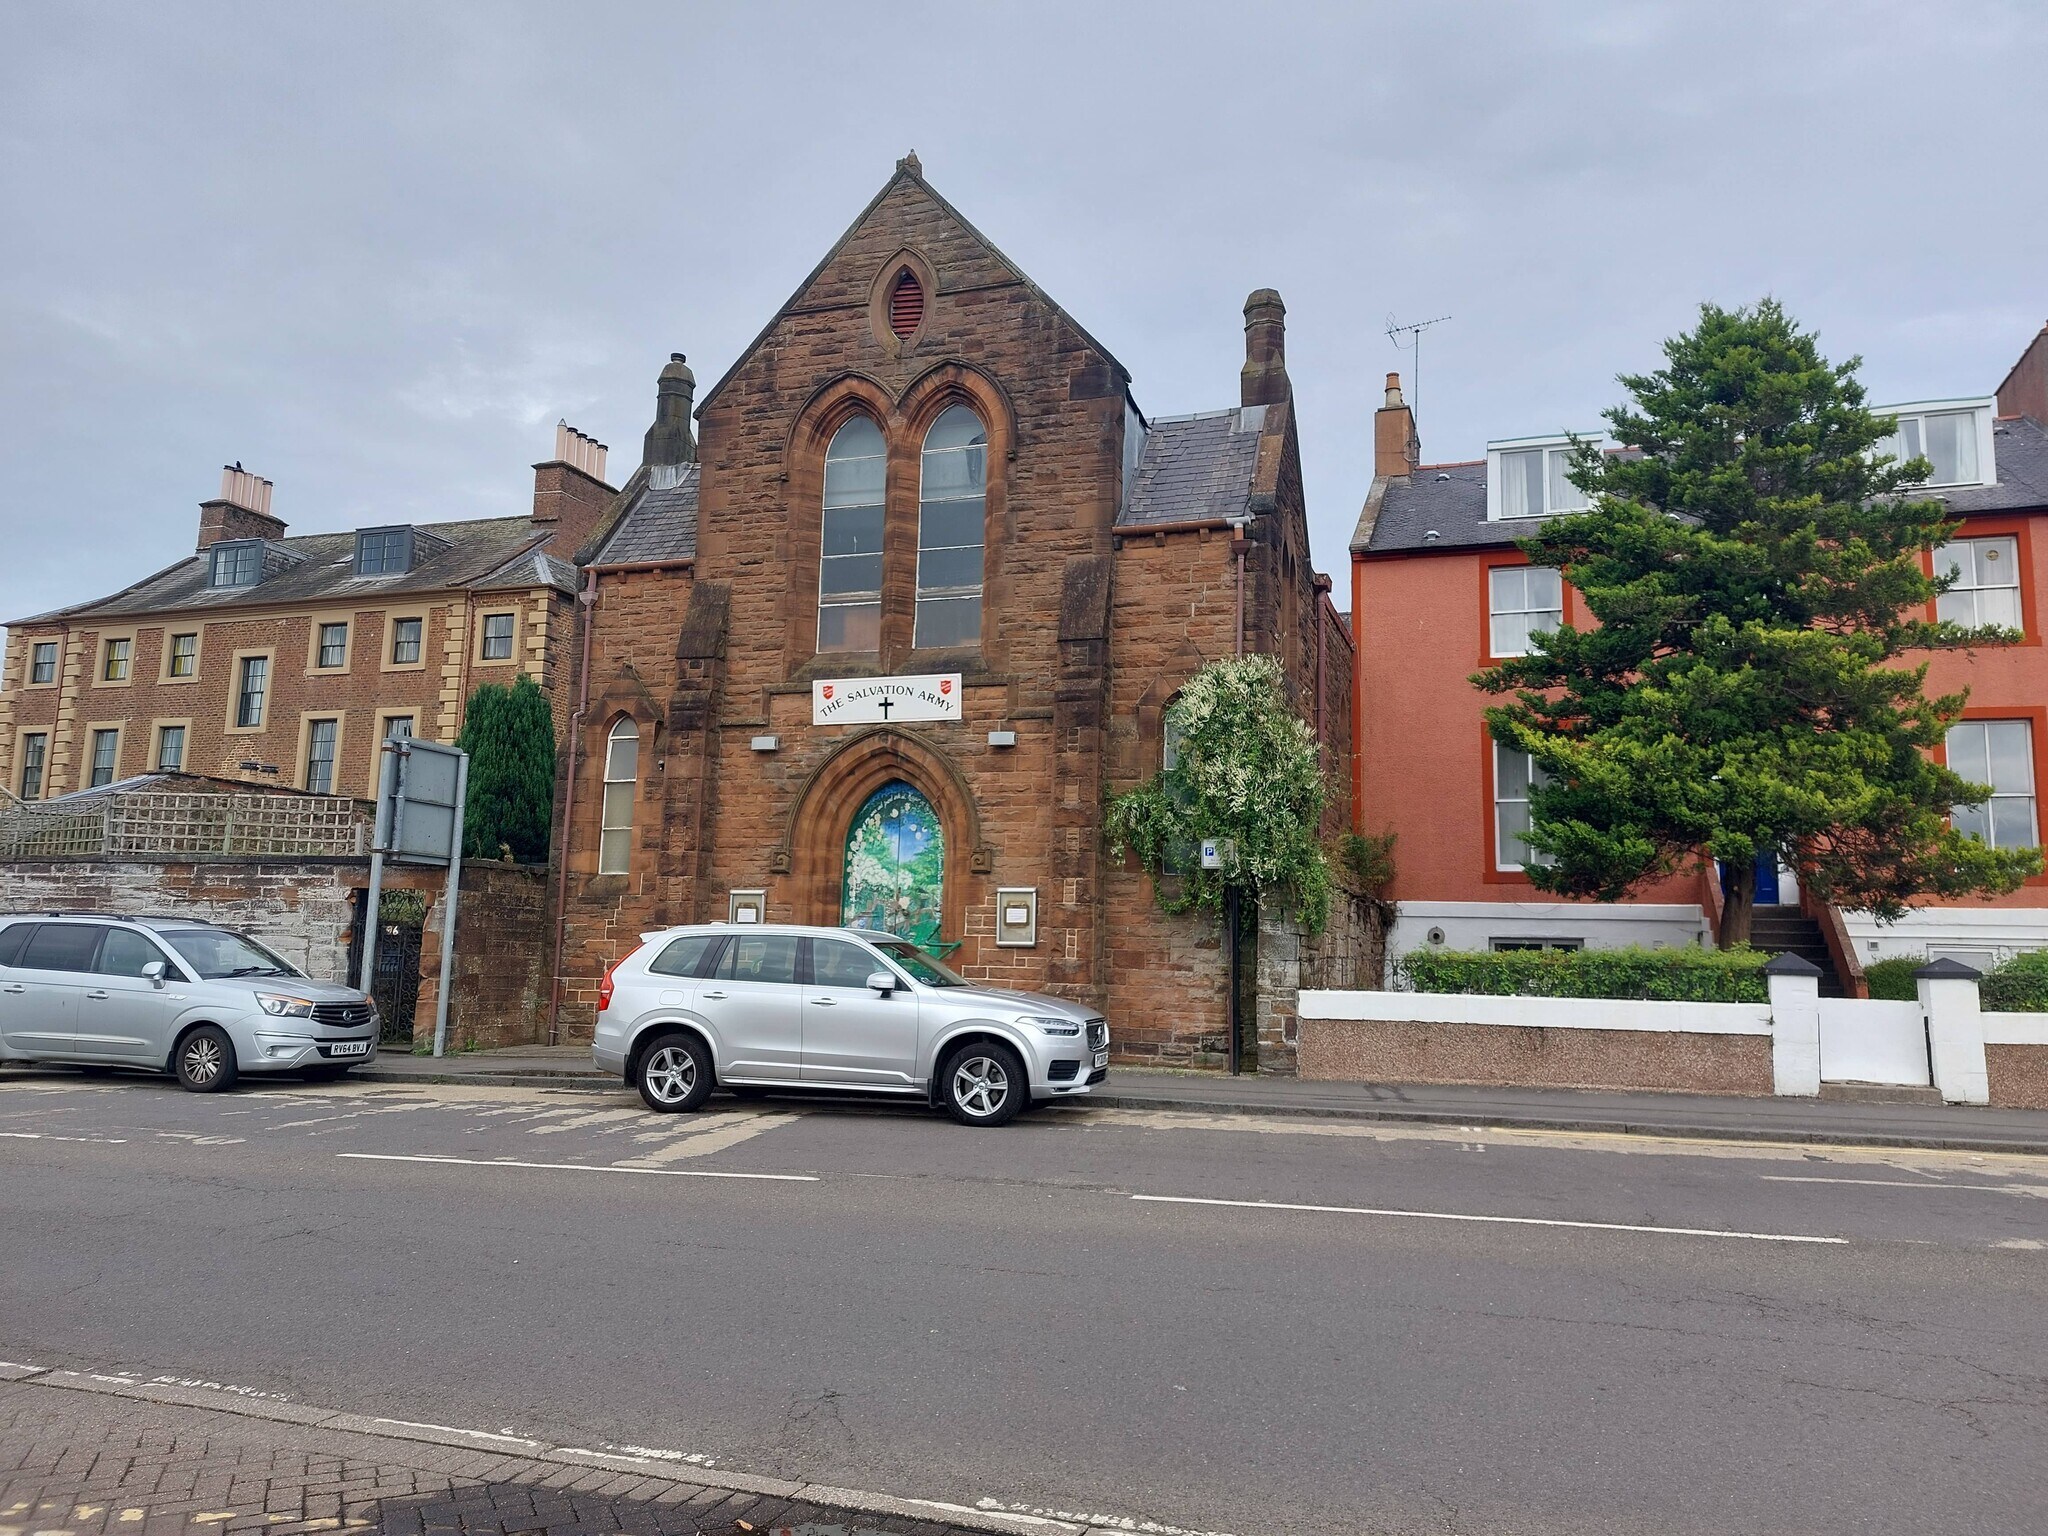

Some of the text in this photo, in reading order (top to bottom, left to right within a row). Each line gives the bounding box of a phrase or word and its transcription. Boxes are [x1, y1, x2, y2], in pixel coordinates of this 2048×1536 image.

[820, 685, 954, 717] THE SALVATION ARMY
[1206, 847, 1213, 856] P
[333, 1043, 365, 1054] RV64 BVJ
